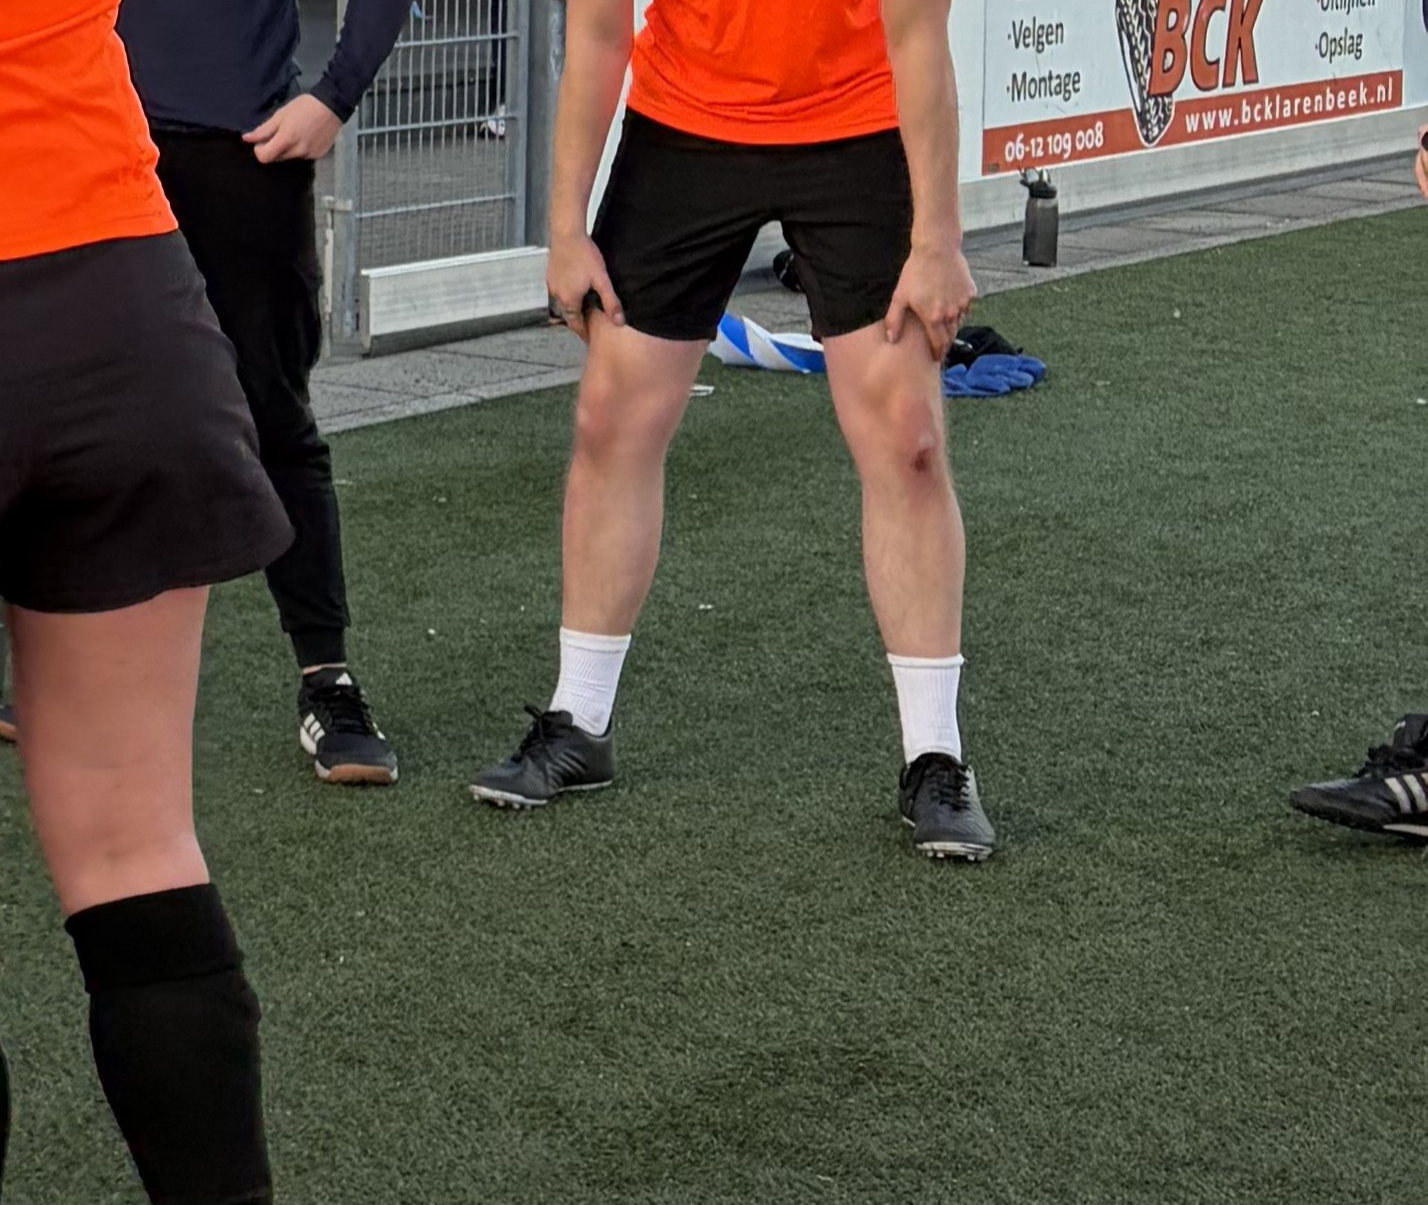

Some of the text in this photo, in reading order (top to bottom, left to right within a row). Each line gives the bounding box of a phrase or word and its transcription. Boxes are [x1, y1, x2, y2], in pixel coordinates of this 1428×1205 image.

[1184, 76, 1394, 134] www.bcklarenbeek.nl
[1004, 120, 1104, 163] 06-12 109 008
